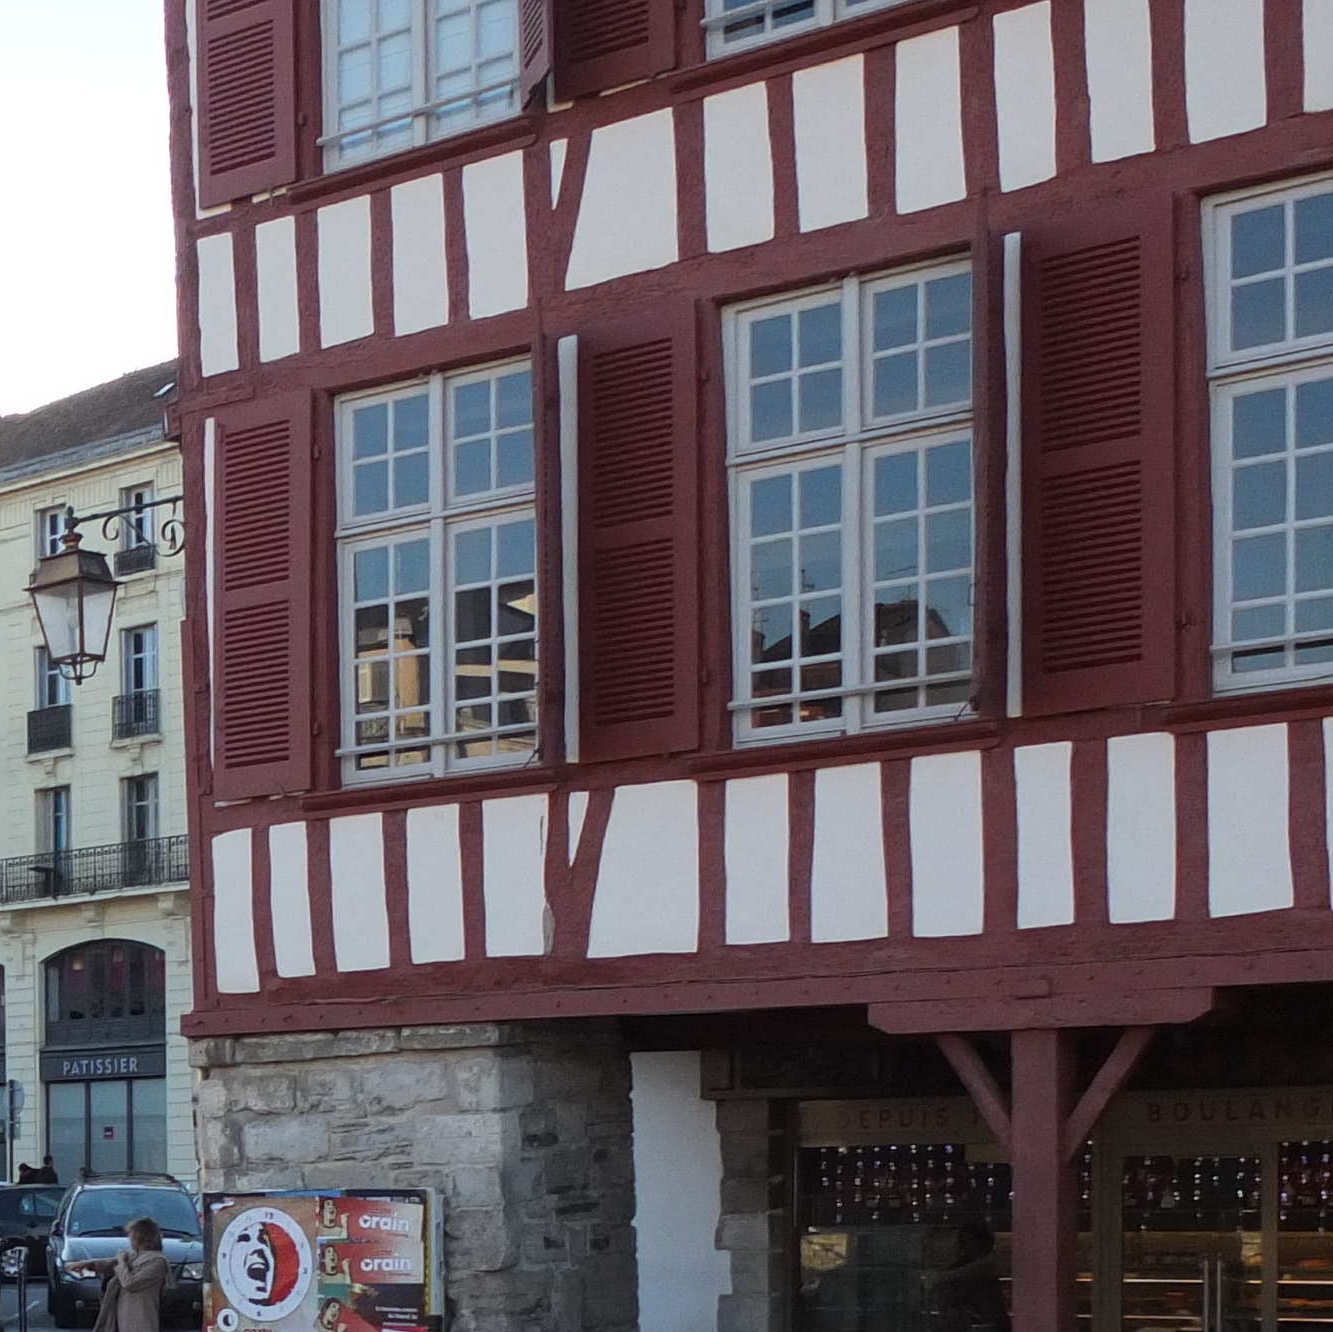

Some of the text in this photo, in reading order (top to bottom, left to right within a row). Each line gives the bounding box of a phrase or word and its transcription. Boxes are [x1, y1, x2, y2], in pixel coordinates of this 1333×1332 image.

[62, 1057, 139, 1076] PATISSIER
[837, 1106, 948, 1131] DEPUIS
[1147, 1096, 1333, 1123] BOULANG
